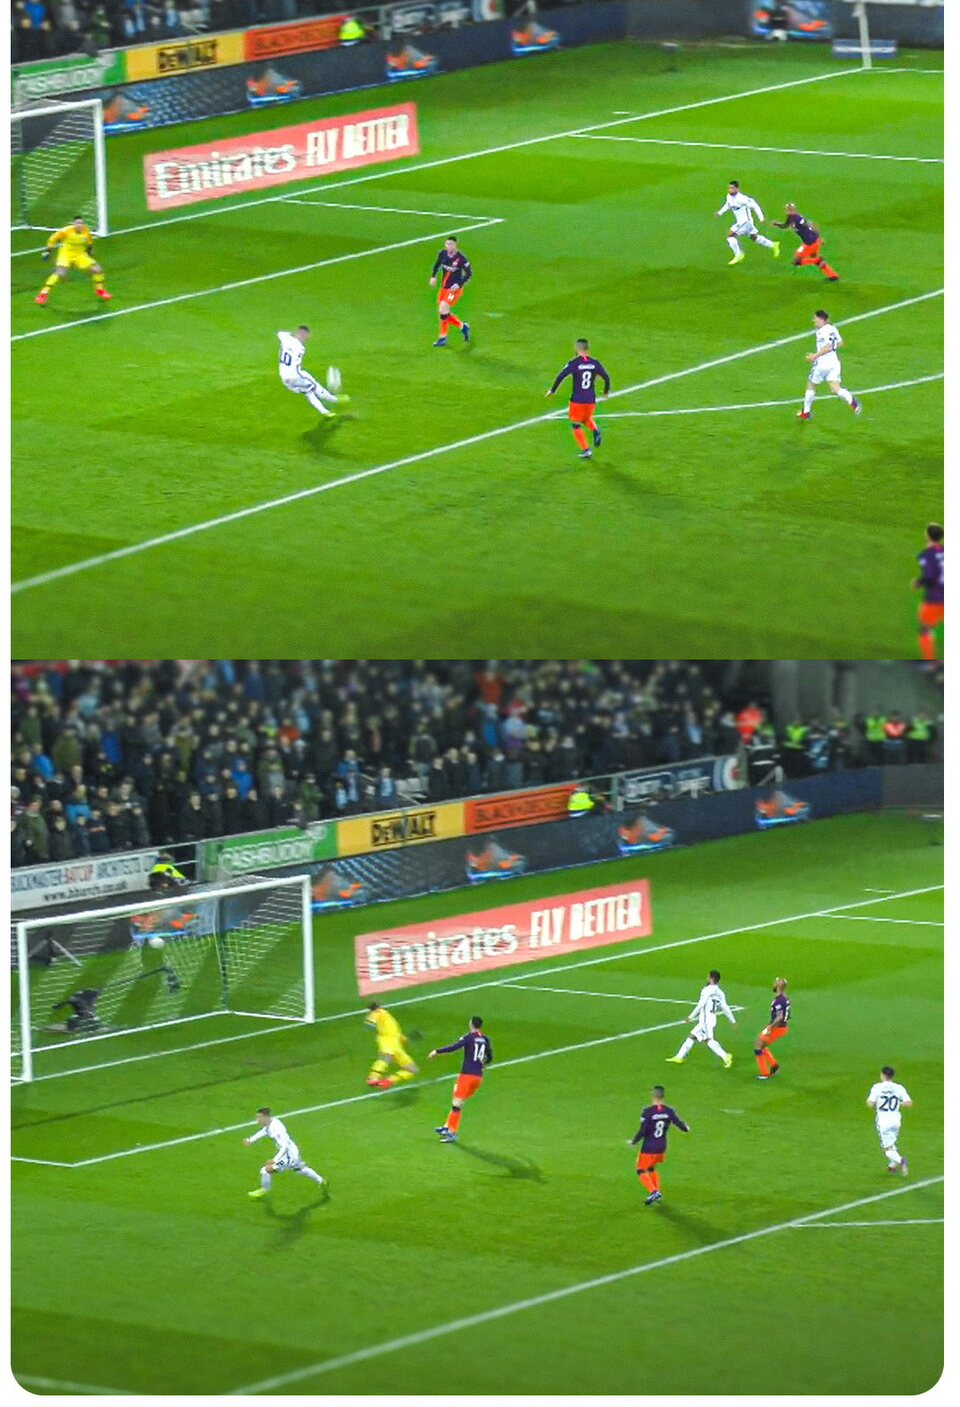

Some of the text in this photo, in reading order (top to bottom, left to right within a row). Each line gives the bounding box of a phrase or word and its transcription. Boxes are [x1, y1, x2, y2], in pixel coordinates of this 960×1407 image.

[154, 114, 409, 199] Emirates FLY BETTER
[581, 370, 592, 389] 8
[366, 892, 642, 982] Emirates FLY BETTER
[473, 1043, 486, 1062] 14
[879, 1095, 899, 1111] 20
[654, 1120, 665, 1138] 8
